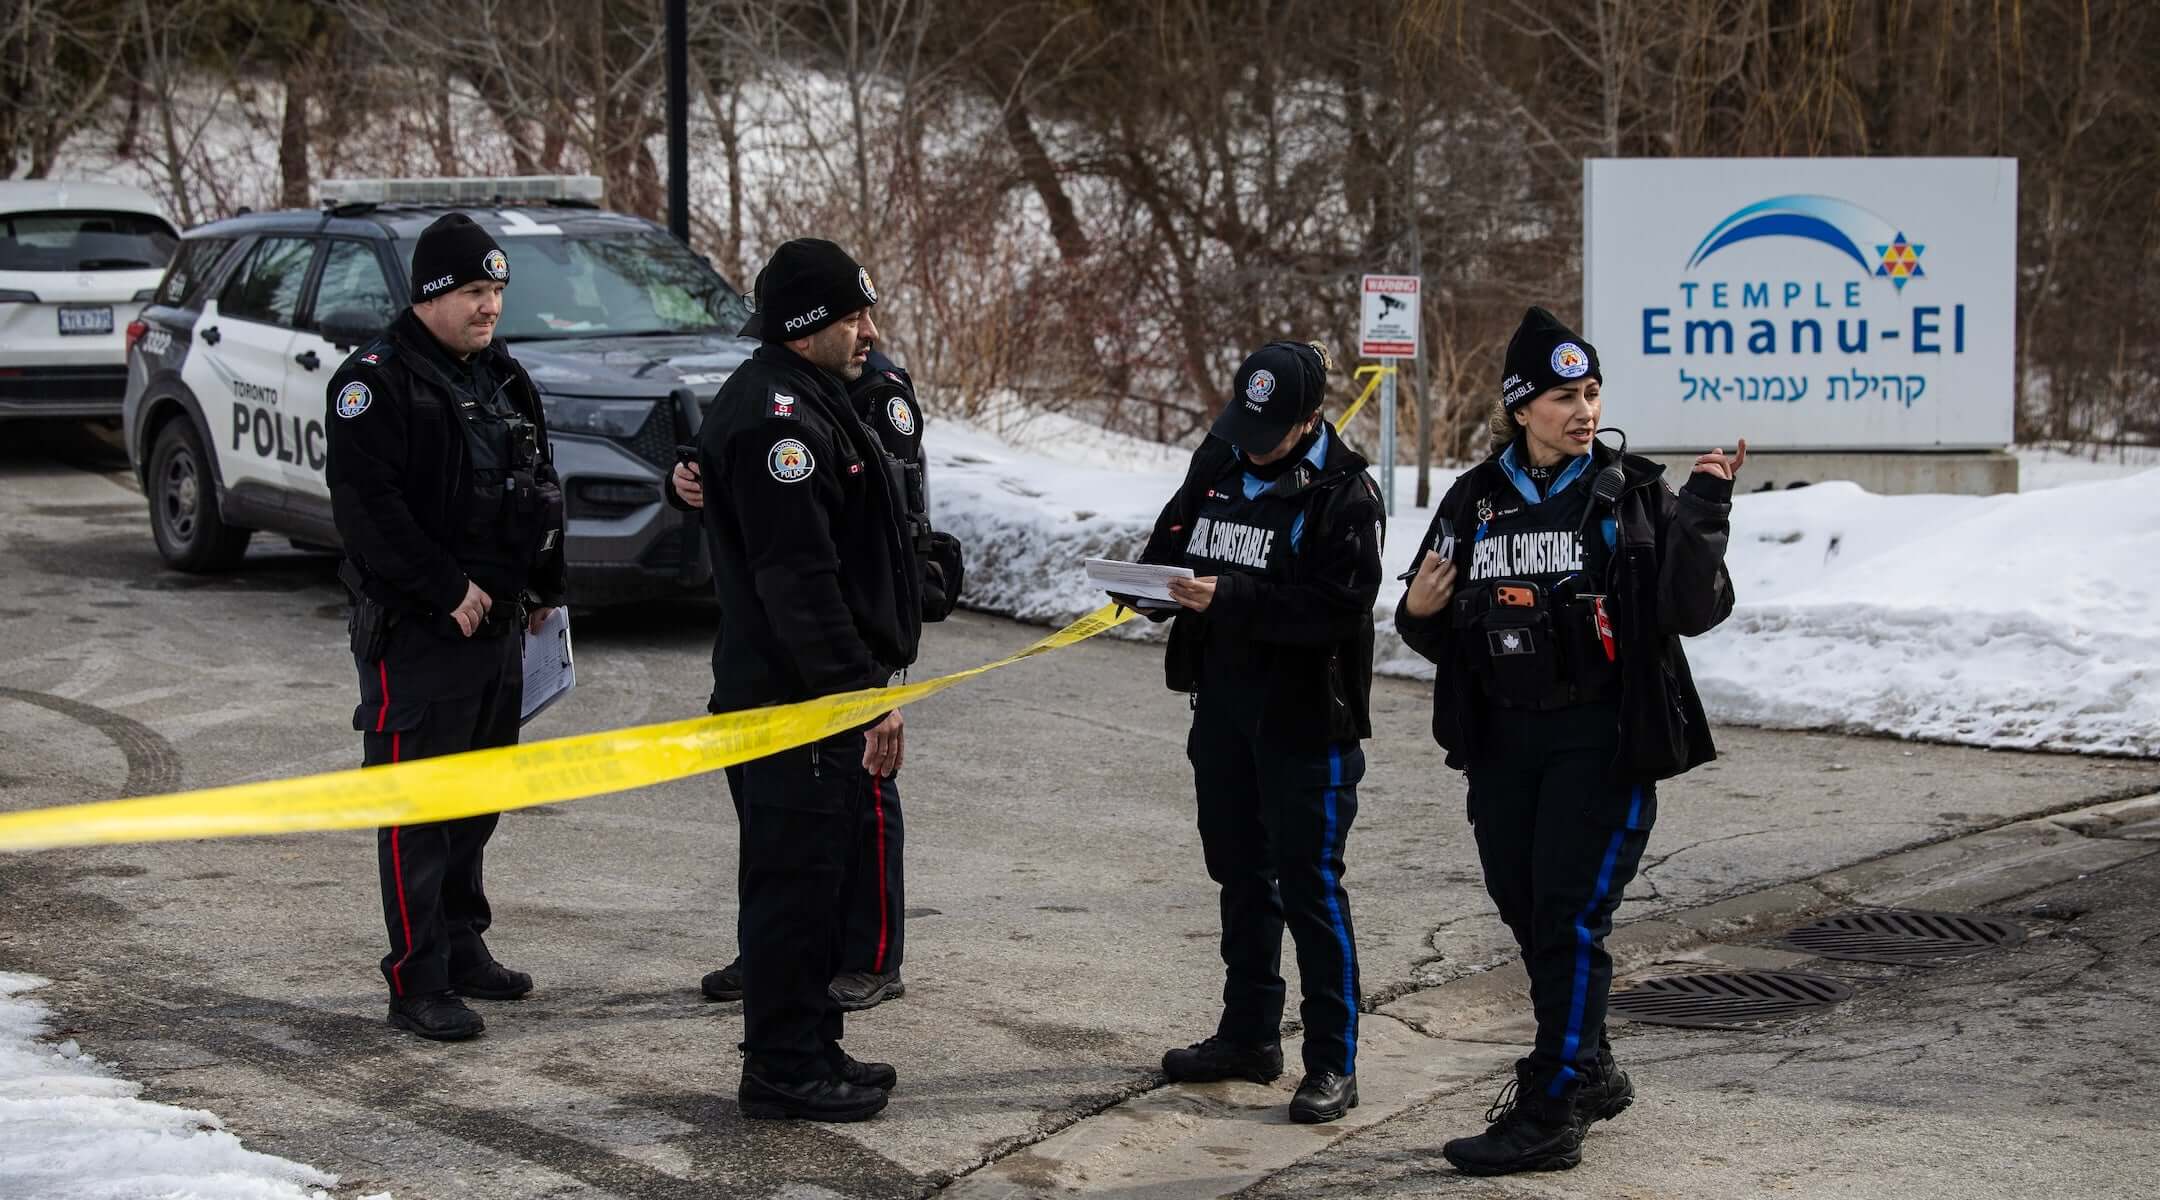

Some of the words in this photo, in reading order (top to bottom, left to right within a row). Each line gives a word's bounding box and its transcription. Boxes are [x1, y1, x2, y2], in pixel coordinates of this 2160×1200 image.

[423, 275, 454, 294] POLICE
[1366, 280, 1415, 292] WARNING
[1680, 282, 1861, 308] TEMPLE
[784, 305, 829, 333] POLICE
[1642, 304, 1966, 355] Emanu-El
[233, 380, 278, 405] TORONTO
[1679, 367, 1809, 402] עמנו-אל
[1826, 368, 1927, 409] קהילת
[232, 402, 326, 471] POLIC
[773, 441, 805, 453] TORONTO
[780, 469, 805, 479] POLICE
[1210, 520, 1274, 569] CONSTABLE
[1470, 535, 1511, 580] SPECIAL
[1512, 531, 1583, 575] CONSTABLE
